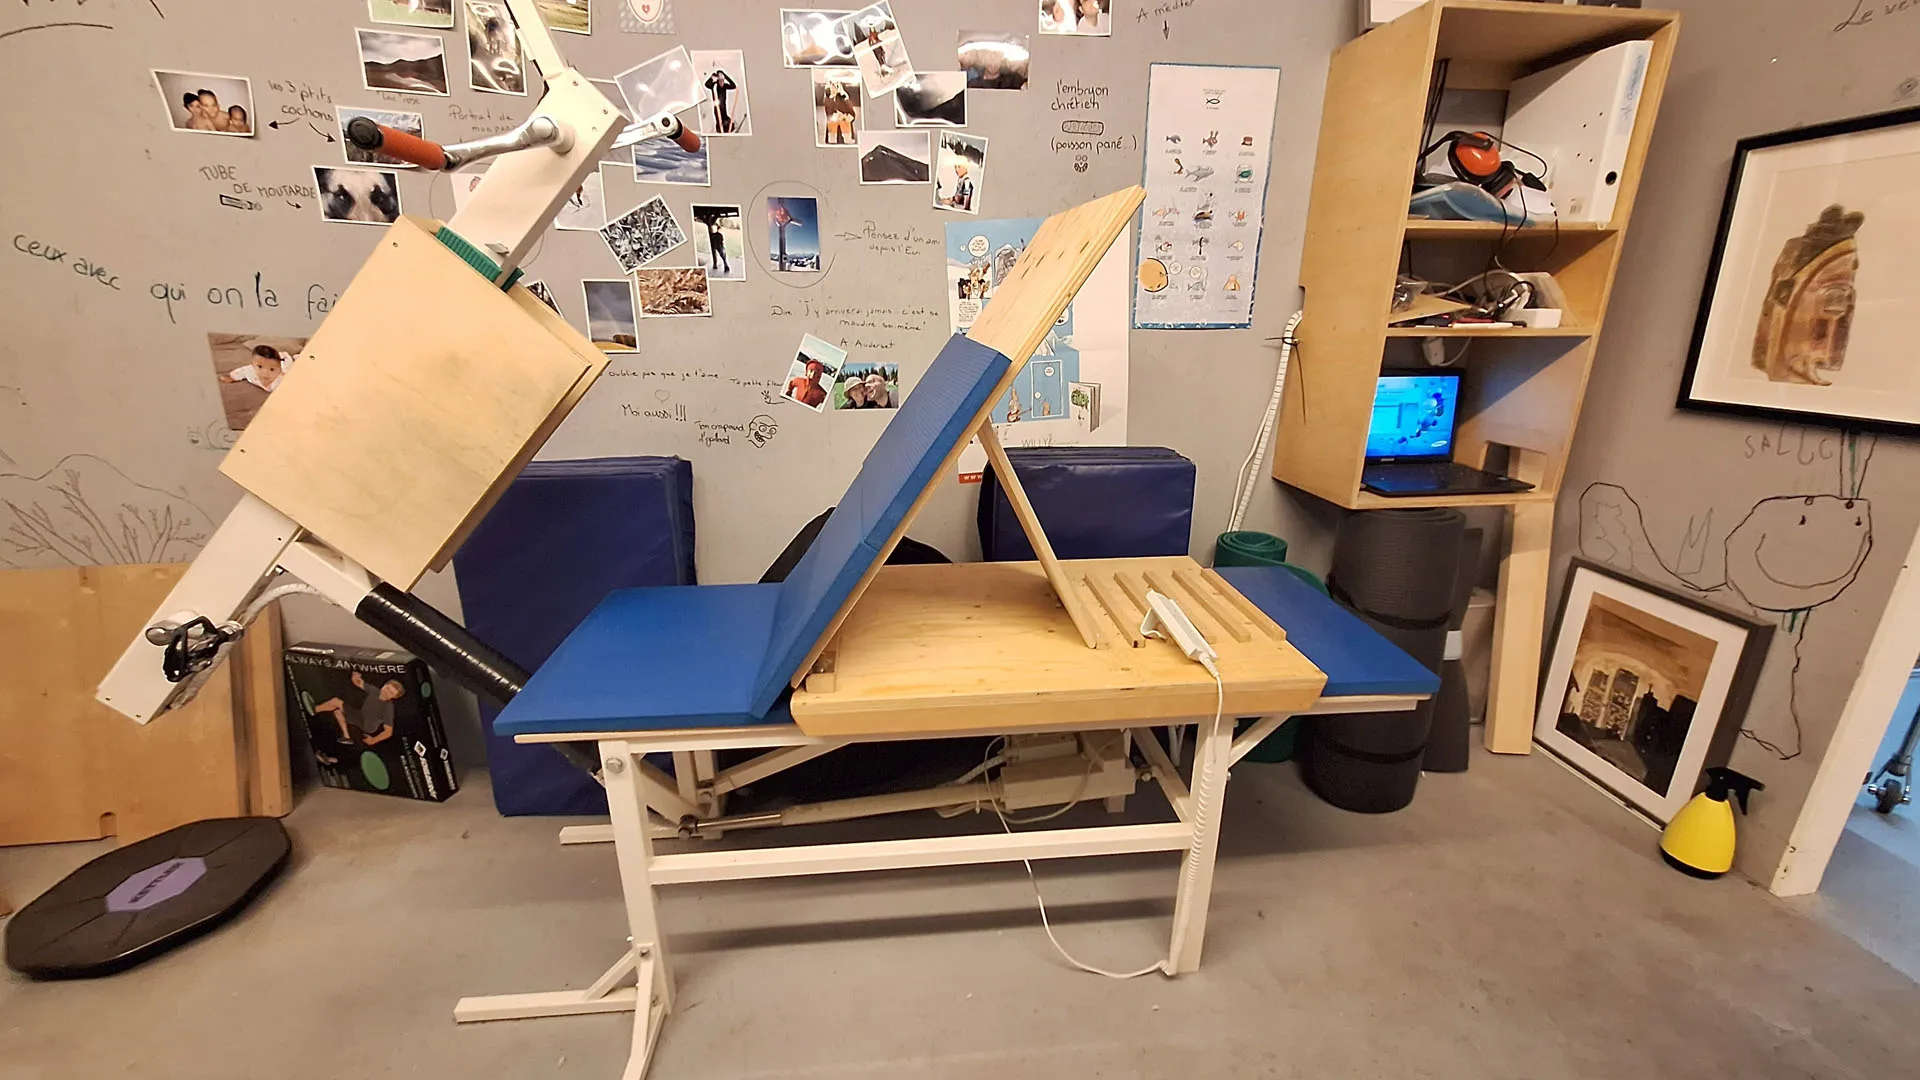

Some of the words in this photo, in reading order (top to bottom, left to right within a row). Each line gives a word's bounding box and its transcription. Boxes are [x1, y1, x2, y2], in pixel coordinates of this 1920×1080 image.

[285, 80, 296, 92] 3
[1056, 79, 1109, 100] l'embryon
[1051, 96, 1100, 111] chrétien
[281, 104, 334, 122] cochons
[1050, 136, 1093, 154] (poisson
[200, 164, 238, 181] TUBE
[233, 182, 251, 195] DE
[257, 184, 317, 199] MOUTARDE
[13, 234, 67, 264] ceux
[73, 257, 121, 291] avec
[150, 283, 187, 325] qui
[207, 287, 244, 309] on
[255, 271, 280, 308] la
[307, 284, 338, 321] fai
[621, 403, 640, 416] Moi
[644, 409, 671, 419] aussi
[335, 660, 407, 674] ANYWHERE
